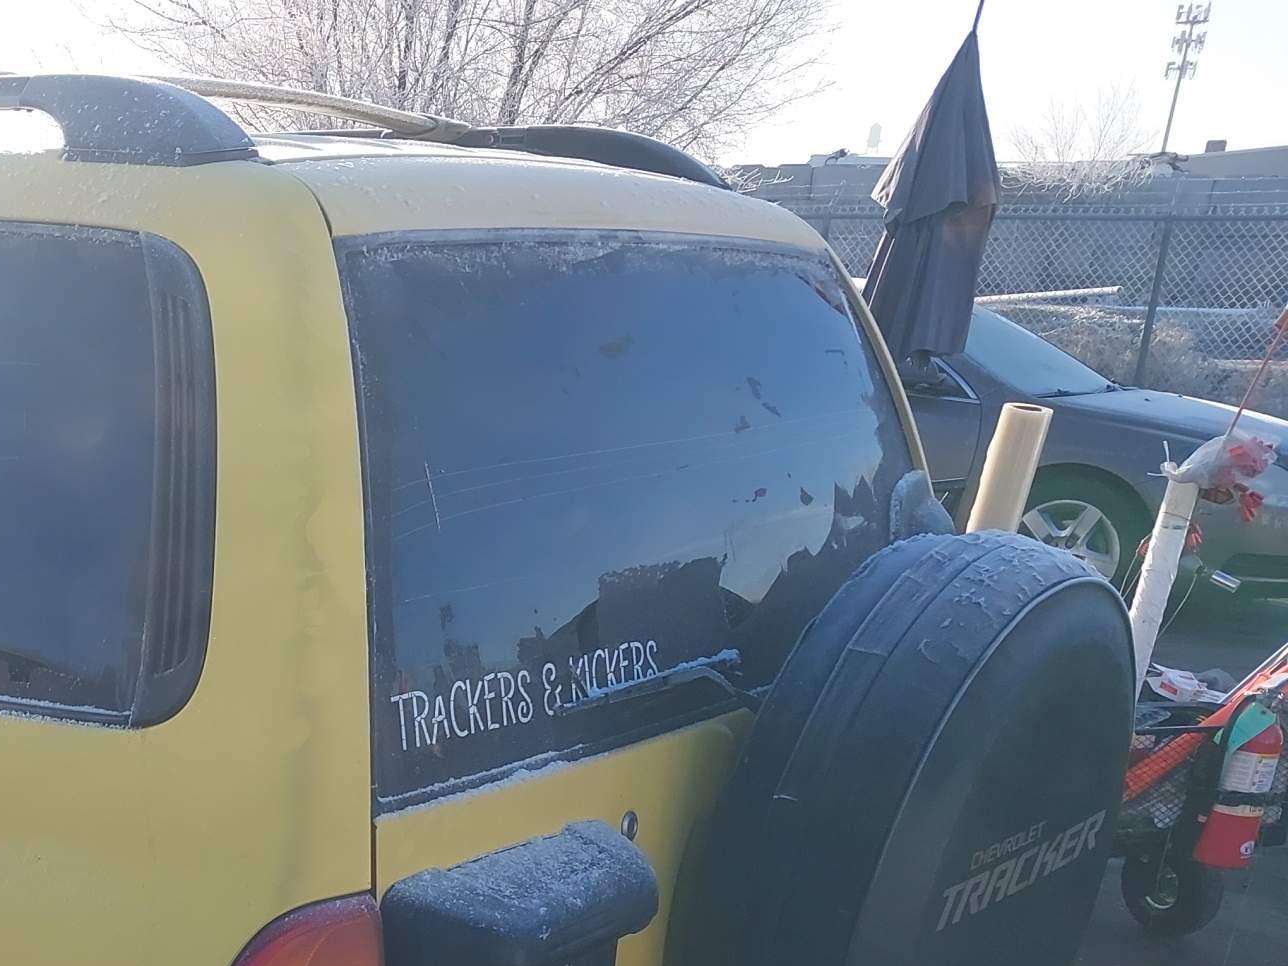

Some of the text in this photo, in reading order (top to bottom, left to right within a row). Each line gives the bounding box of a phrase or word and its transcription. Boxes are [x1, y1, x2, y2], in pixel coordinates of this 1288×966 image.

[390, 669, 534, 751] TRACKERS
[541, 662, 562, 717] &
[936, 809, 1107, 933] TRACKER
[970, 821, 1048, 871] CHEVROLET
